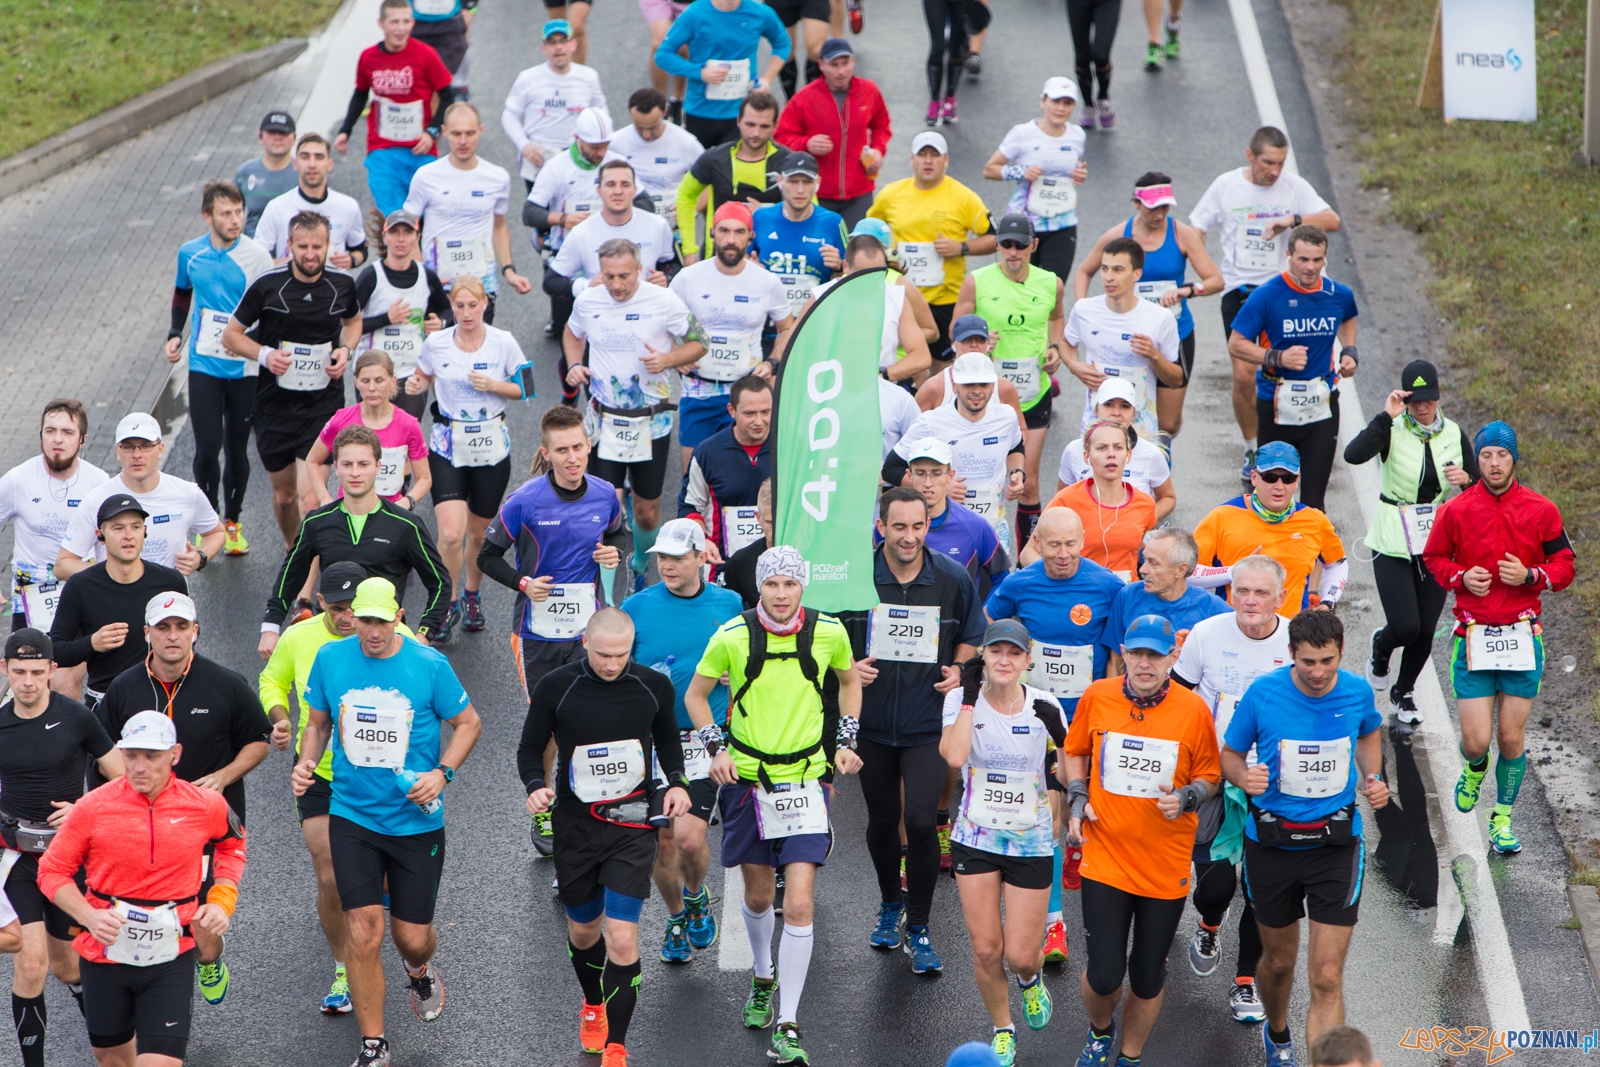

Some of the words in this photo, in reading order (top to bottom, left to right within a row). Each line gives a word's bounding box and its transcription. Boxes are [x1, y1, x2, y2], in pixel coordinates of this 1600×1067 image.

[1455, 52, 1505, 68] inea
[387, 114, 415, 125] 5044
[1039, 190, 1069, 202] 6645
[1244, 239, 1275, 252] 2329
[450, 250, 473, 262] 383
[769, 252, 807, 275] 21.1
[786, 289, 811, 300] 606
[1283, 317, 1336, 333] DUKAT
[383, 340, 414, 351] 6679
[711, 348, 740, 360] 1025
[294, 360, 321, 371] 1276
[1002, 373, 1032, 384] 762
[1291, 395, 1320, 406] 5241
[468, 436, 493, 448] 476
[957, 452, 975, 460] SIŁA
[962, 457, 997, 466] ODWAGA
[957, 464, 996, 473] SZYBKOŚĆ
[963, 503, 992, 515] 257
[45, 518, 70, 527] ODWA
[144, 538, 168, 547] WAGA
[142, 545, 168, 555] BKOŚĆ
[812, 572, 848, 581] maraton
[548, 602, 580, 614] 4751
[889, 610, 908, 618] 17.PKO
[888, 624, 924, 639] 2219
[893, 638, 917, 646] Tomasz
[1486, 639, 1519, 653] 5013
[1044, 662, 1075, 675] 1501
[1048, 676, 1070, 684] Roman
[358, 713, 376, 721] 17.PKO
[354, 728, 398, 743] 4806
[985, 743, 1002, 751] SIŁA
[1124, 741, 1143, 750] 17.PKO
[1299, 746, 1319, 754] 17.PKO
[589, 749, 608, 757] 17.PKO
[684, 747, 706, 762] 871
[990, 752, 1028, 761] ODWAGA
[589, 761, 628, 776] 1989
[984, 760, 1027, 769] SZYBKOŚĆ
[1118, 755, 1161, 773] 3228
[1298, 759, 1336, 773] 3481
[987, 774, 1006, 783] 17.PKO
[1126, 771, 1151, 781] Tomasz
[1502, 766, 1521, 803] Kalenji
[984, 788, 1025, 805] 3994
[775, 796, 809, 812] 6701
[986, 804, 1020, 814] Magdalena
[129, 910, 148, 921] 17.PKO
[128, 927, 164, 941] 5715
